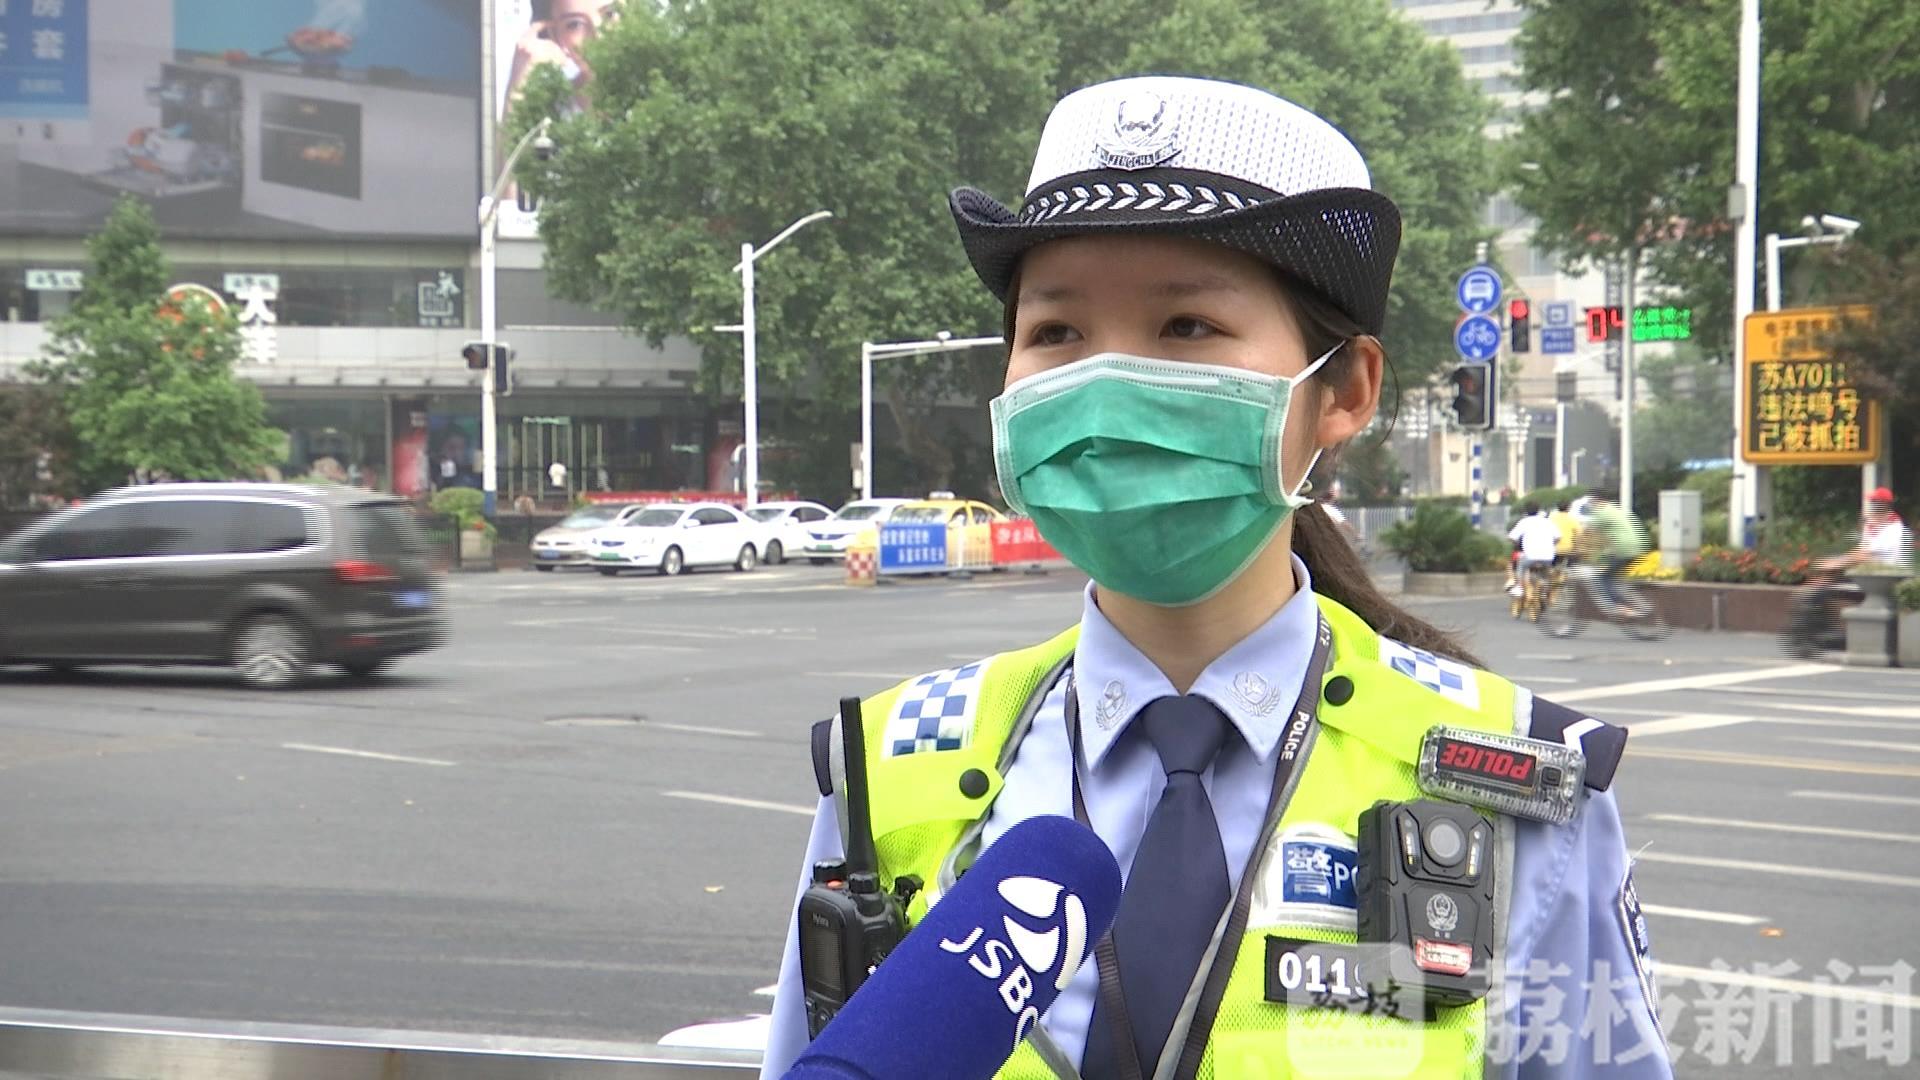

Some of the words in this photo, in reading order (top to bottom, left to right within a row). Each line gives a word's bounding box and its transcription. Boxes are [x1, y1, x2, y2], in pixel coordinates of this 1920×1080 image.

[1757, 388, 1861, 421] 违法鸣号
[1758, 420, 1860, 452] 已被抓拍
[1281, 711, 1311, 761] POLICE
[1439, 742, 1533, 781] POLICE
[1287, 847, 1332, 897] 警
